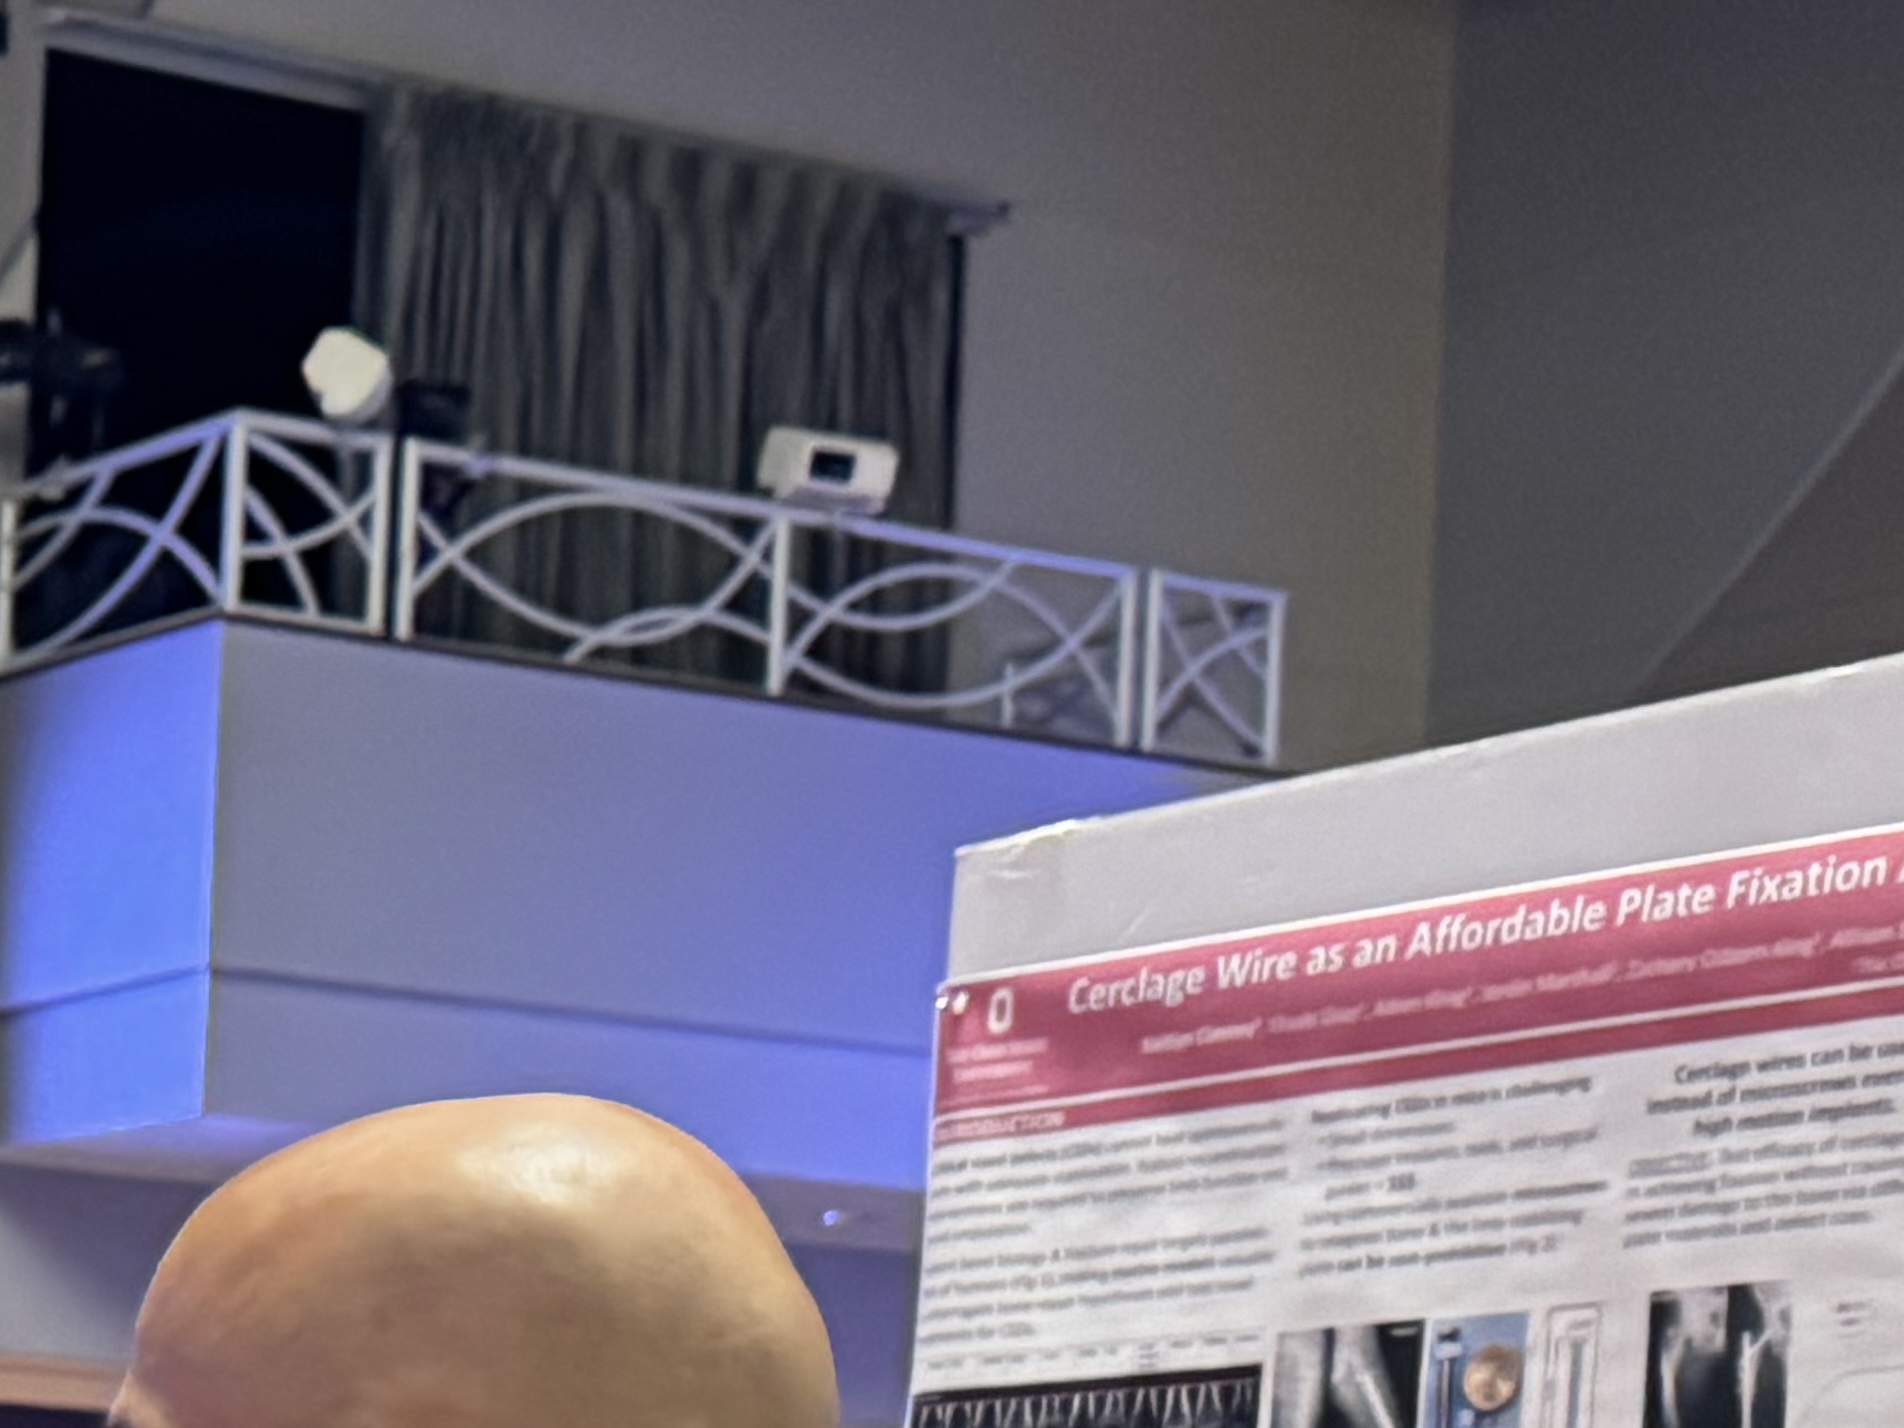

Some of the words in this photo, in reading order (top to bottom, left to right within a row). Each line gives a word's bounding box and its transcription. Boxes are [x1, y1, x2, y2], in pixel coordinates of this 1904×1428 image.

[1068, 963, 1205, 1016] Cerclage
[1216, 949, 1294, 990] Wire
[1306, 943, 1343, 976] as
[1353, 934, 1397, 970] an
[1404, 898, 1607, 961] Affordable
[1616, 881, 1716, 927] Plate
[1726, 854, 1888, 910] Fixation
